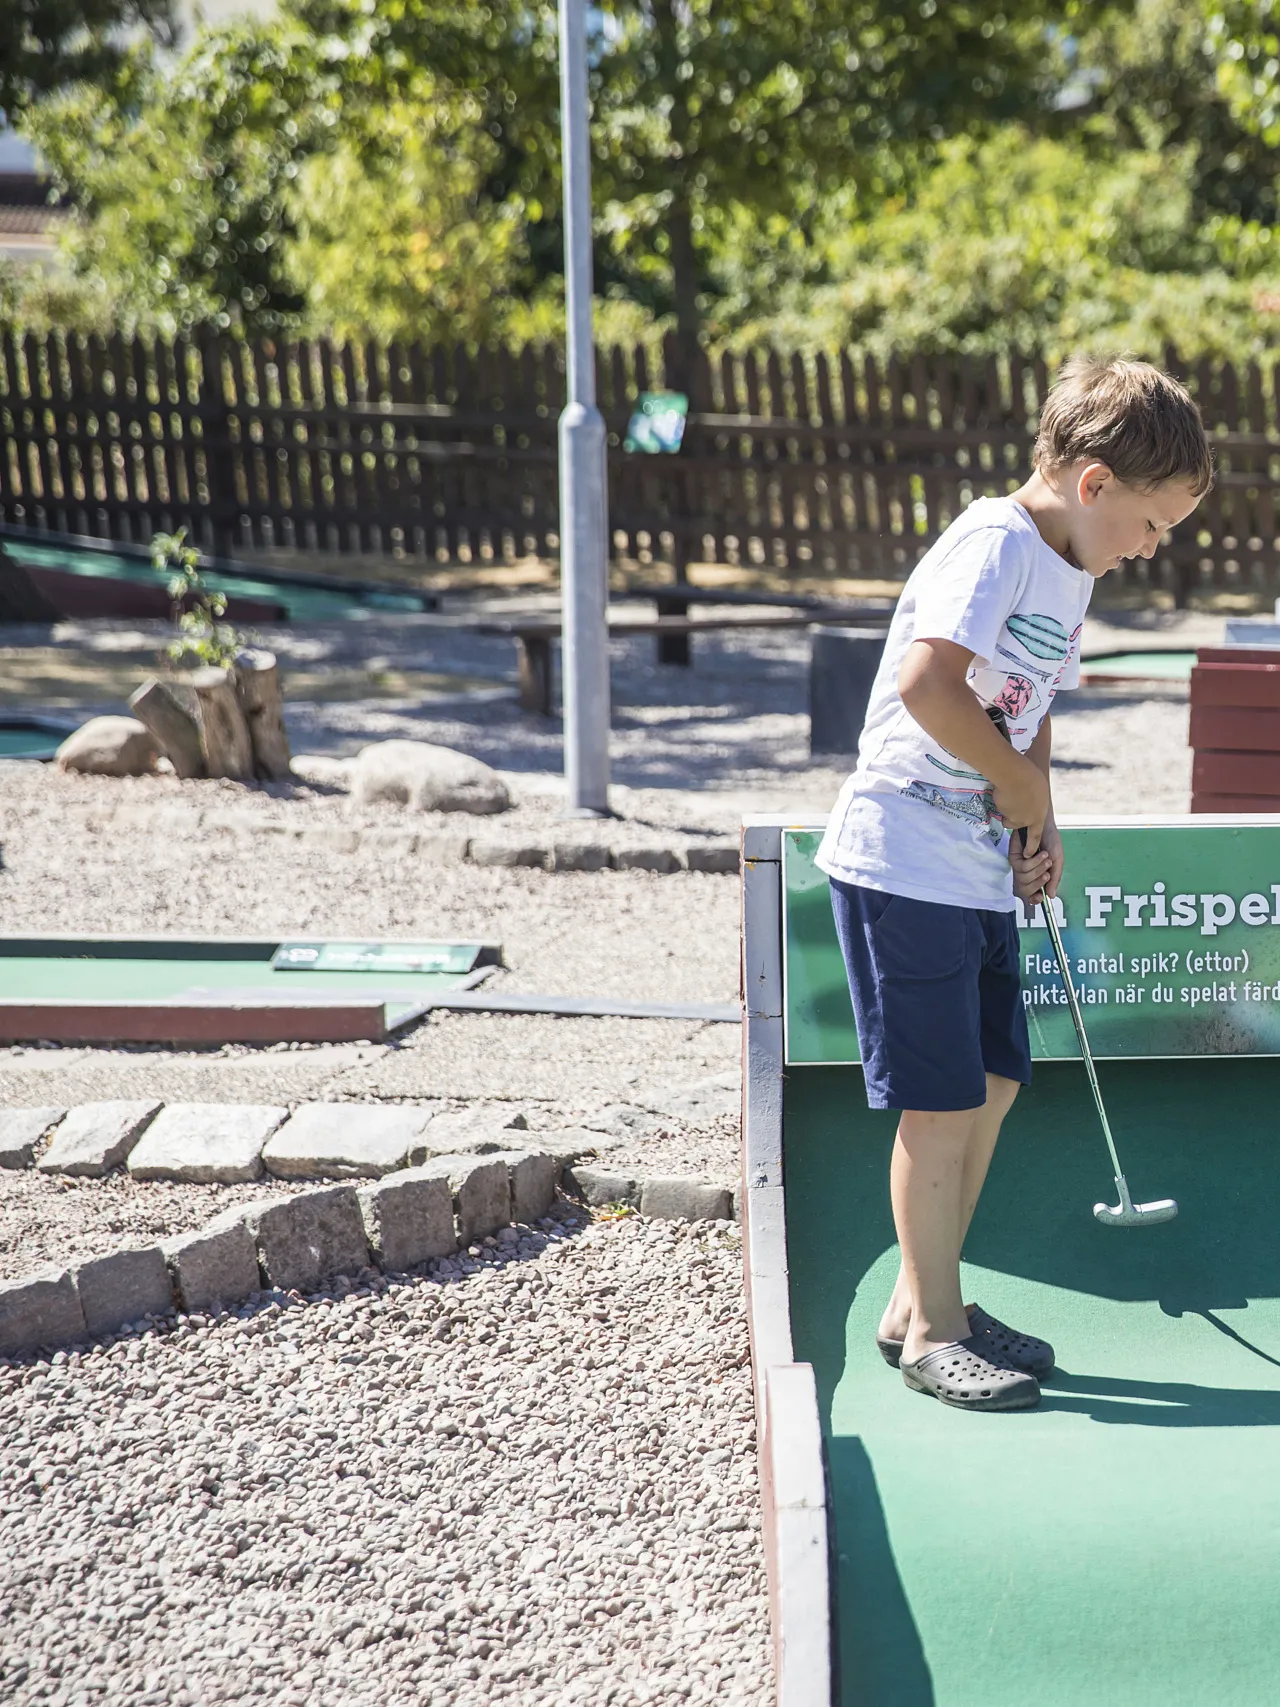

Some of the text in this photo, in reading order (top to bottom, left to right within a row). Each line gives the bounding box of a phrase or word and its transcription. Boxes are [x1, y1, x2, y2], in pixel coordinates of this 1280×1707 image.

[1025, 949, 1249, 978] Fles antal spik? (ettor)
[1115, 983, 1146, 1004] när
[1152, 982, 1173, 1003] du
[1180, 981, 1237, 1008] spelat
